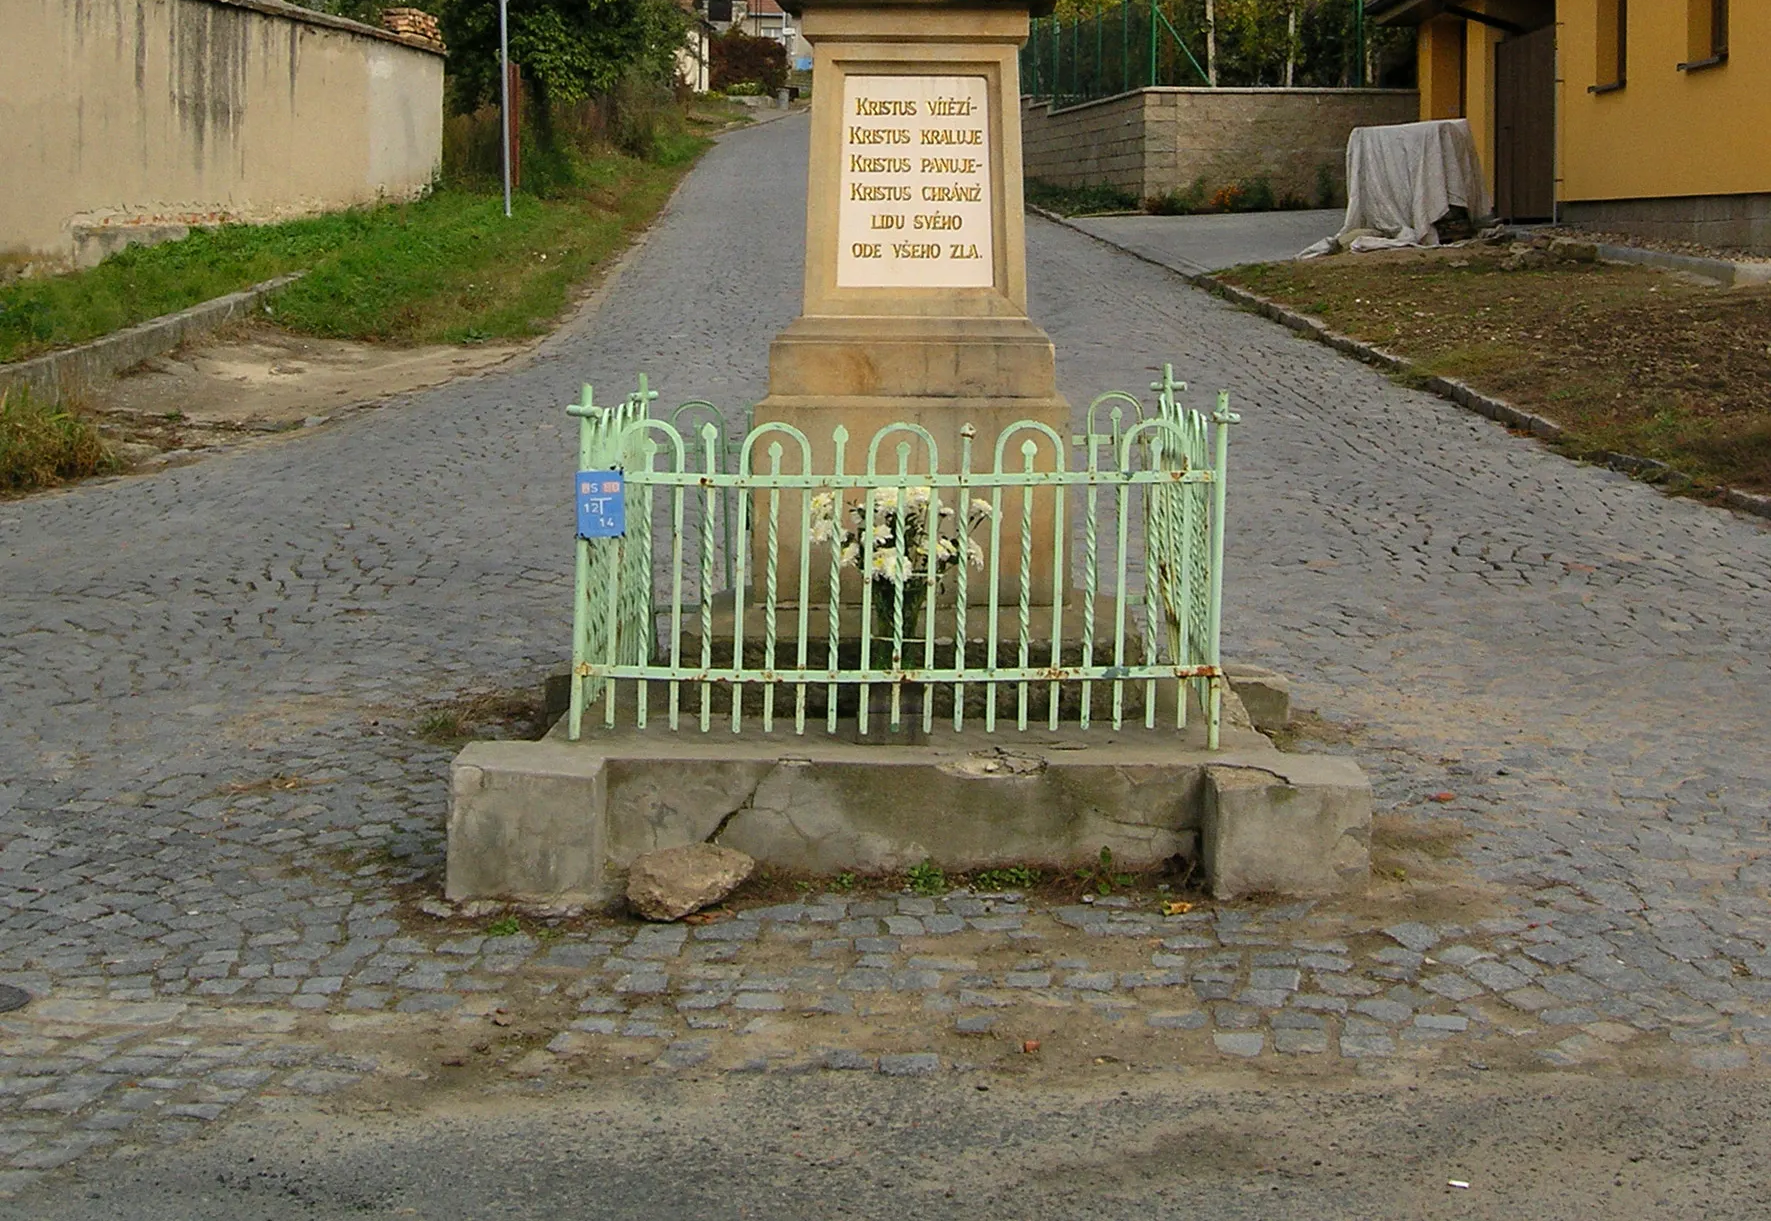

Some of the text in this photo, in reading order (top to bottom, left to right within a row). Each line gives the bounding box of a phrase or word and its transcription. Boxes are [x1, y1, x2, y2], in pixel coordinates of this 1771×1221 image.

[855, 97, 917, 116] KRISTUS
[849, 126, 983, 145] KRISTUS KRALUJE
[850, 154, 911, 173] KRISTUS
[850, 182, 982, 202] KRISTUS CHRÁNIŽ
[870, 210, 962, 230] LIDU SVÉHO
[851, 240, 983, 259] ODE VŠEHO ZLA.
